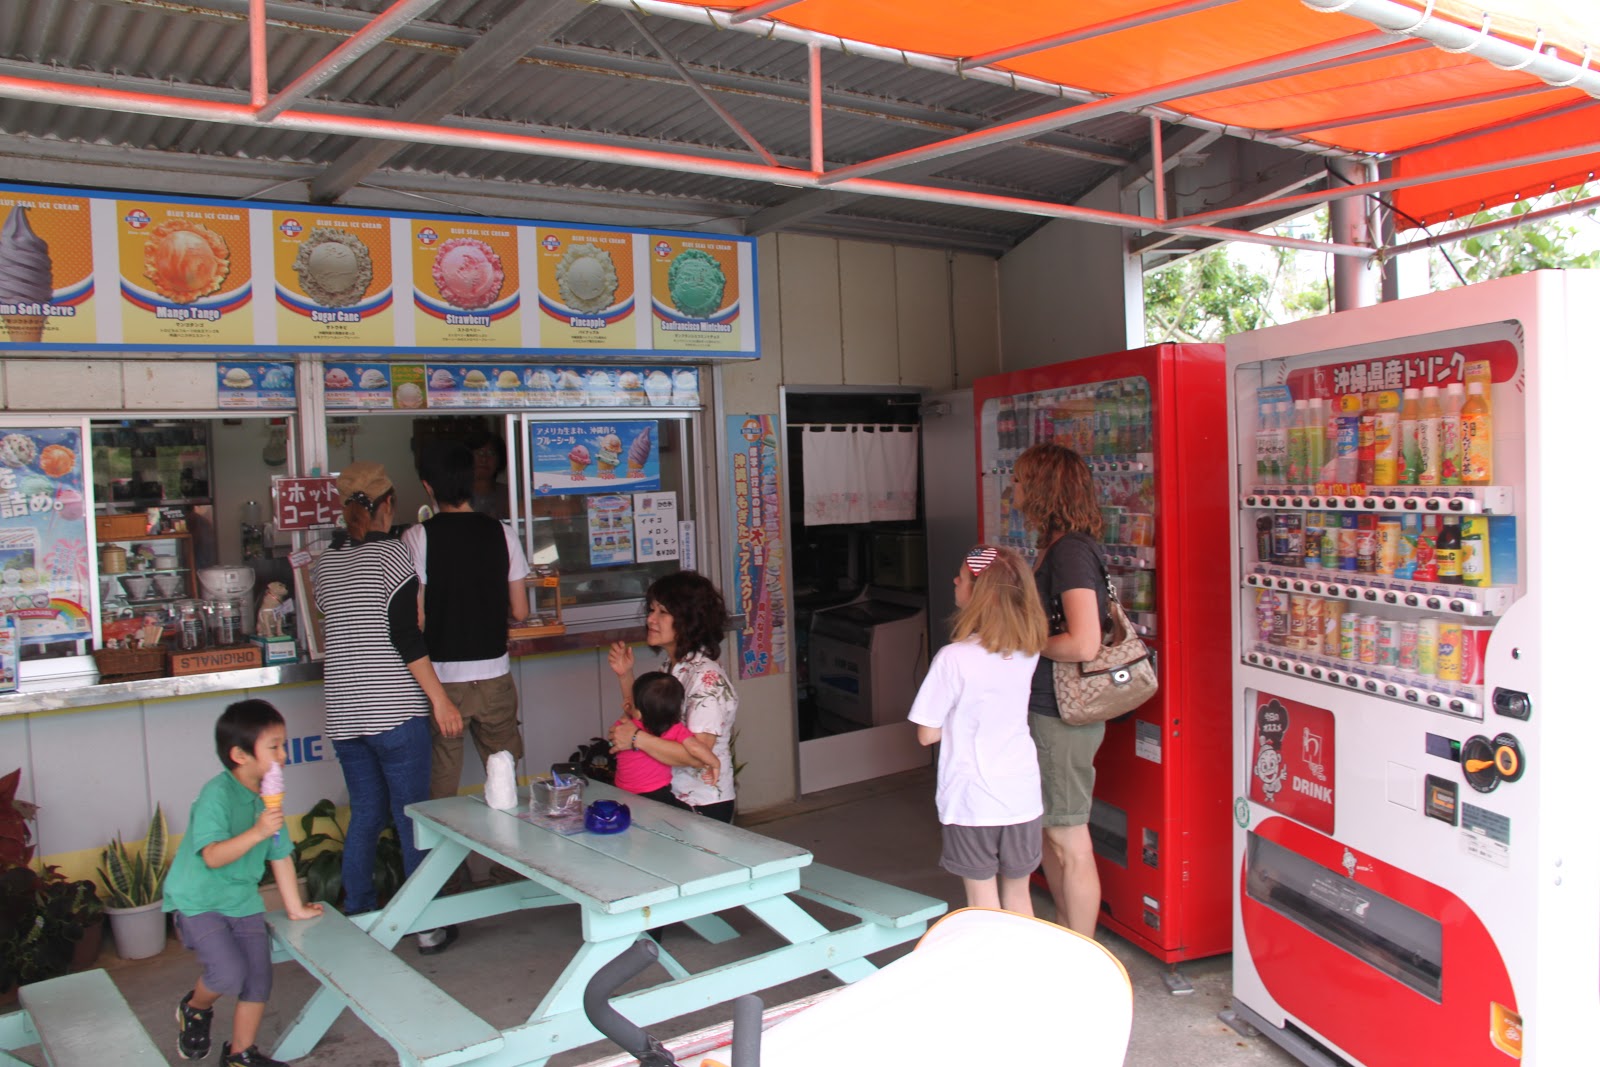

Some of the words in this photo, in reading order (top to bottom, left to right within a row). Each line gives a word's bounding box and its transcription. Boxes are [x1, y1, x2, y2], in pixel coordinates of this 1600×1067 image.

[18, 302, 41, 315] Soft
[42, 303, 75, 316] Serve
[156, 306, 190, 320] Mango
[190, 307, 220, 321] Tango
[311, 310, 336, 323] Sugar
[337, 311, 360, 322] Cane
[446, 313, 490, 327] Strawberry
[570, 316, 606, 329] Pineapple
[1333, 351, 1466, 395] 沖縄県産ドリンク
[536, 436, 576, 446] ブルーシール
[180, 651, 256, 669] ORIGINALS
[1292, 776, 1333, 805] DRINK
